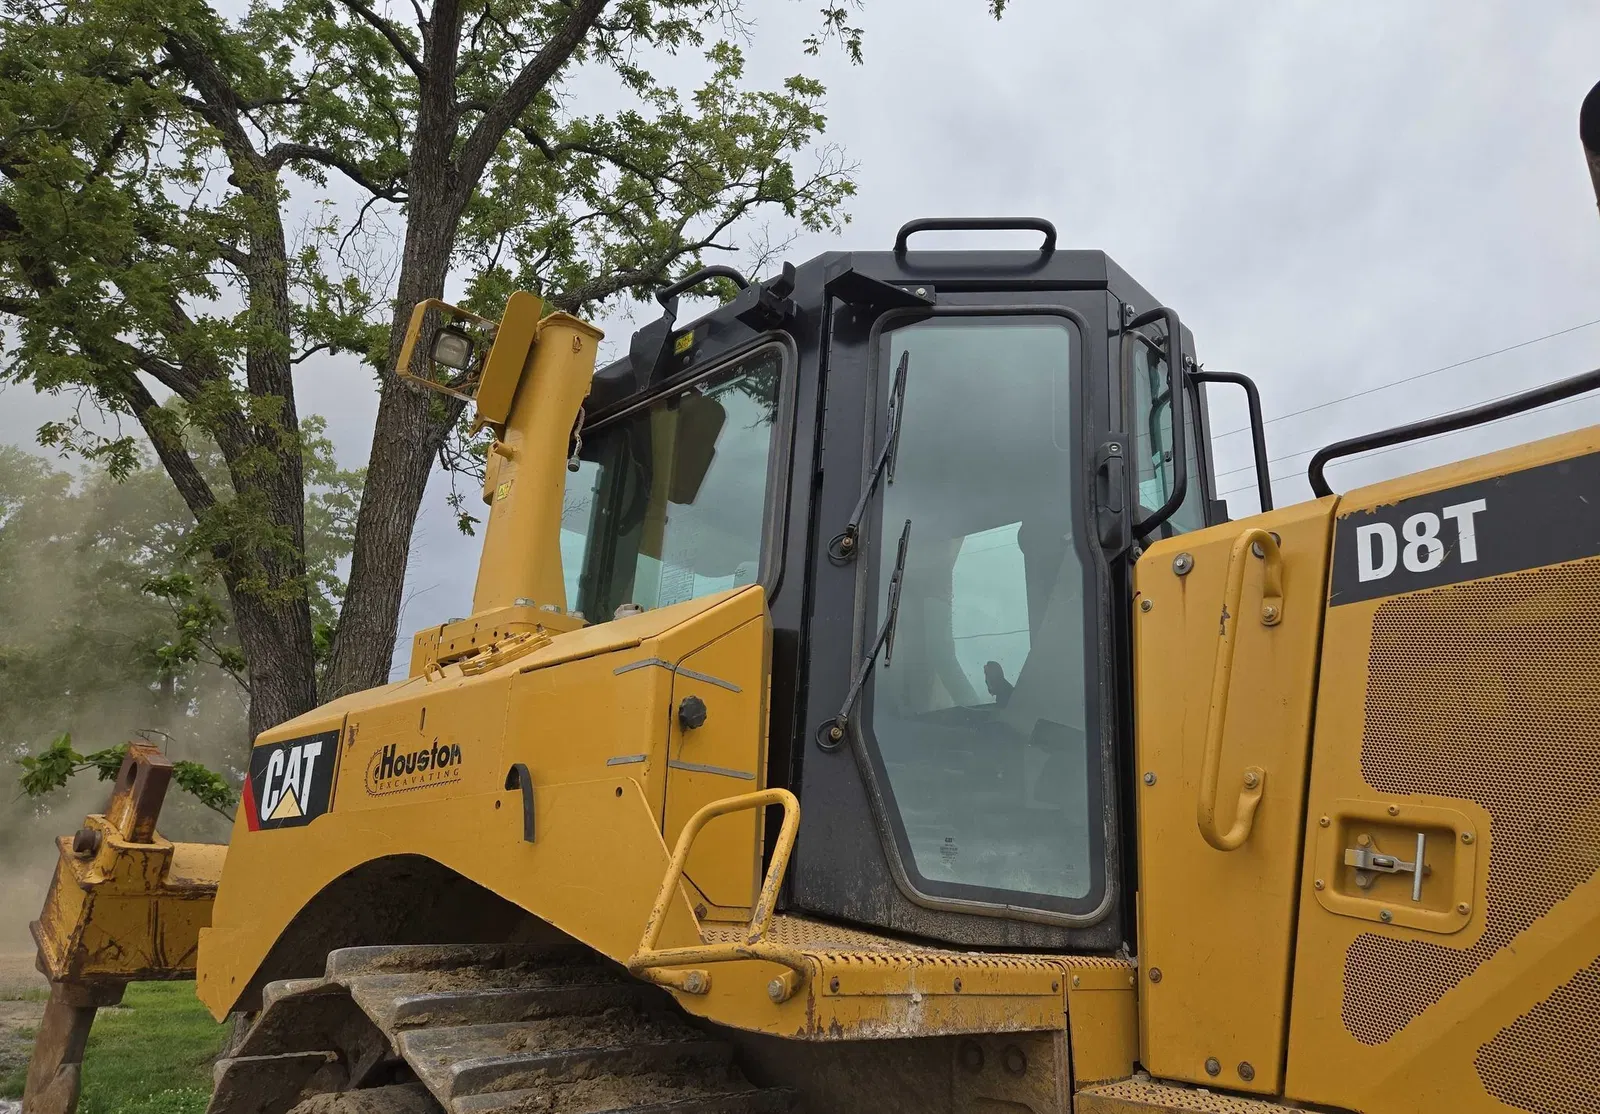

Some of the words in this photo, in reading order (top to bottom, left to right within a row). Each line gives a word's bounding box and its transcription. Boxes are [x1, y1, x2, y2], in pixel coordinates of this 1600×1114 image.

[1356, 498, 1487, 583] D8T
[261, 741, 323, 821] CAT
[379, 768, 460, 790] EXCAVATING
[380, 738, 462, 780] Houston
